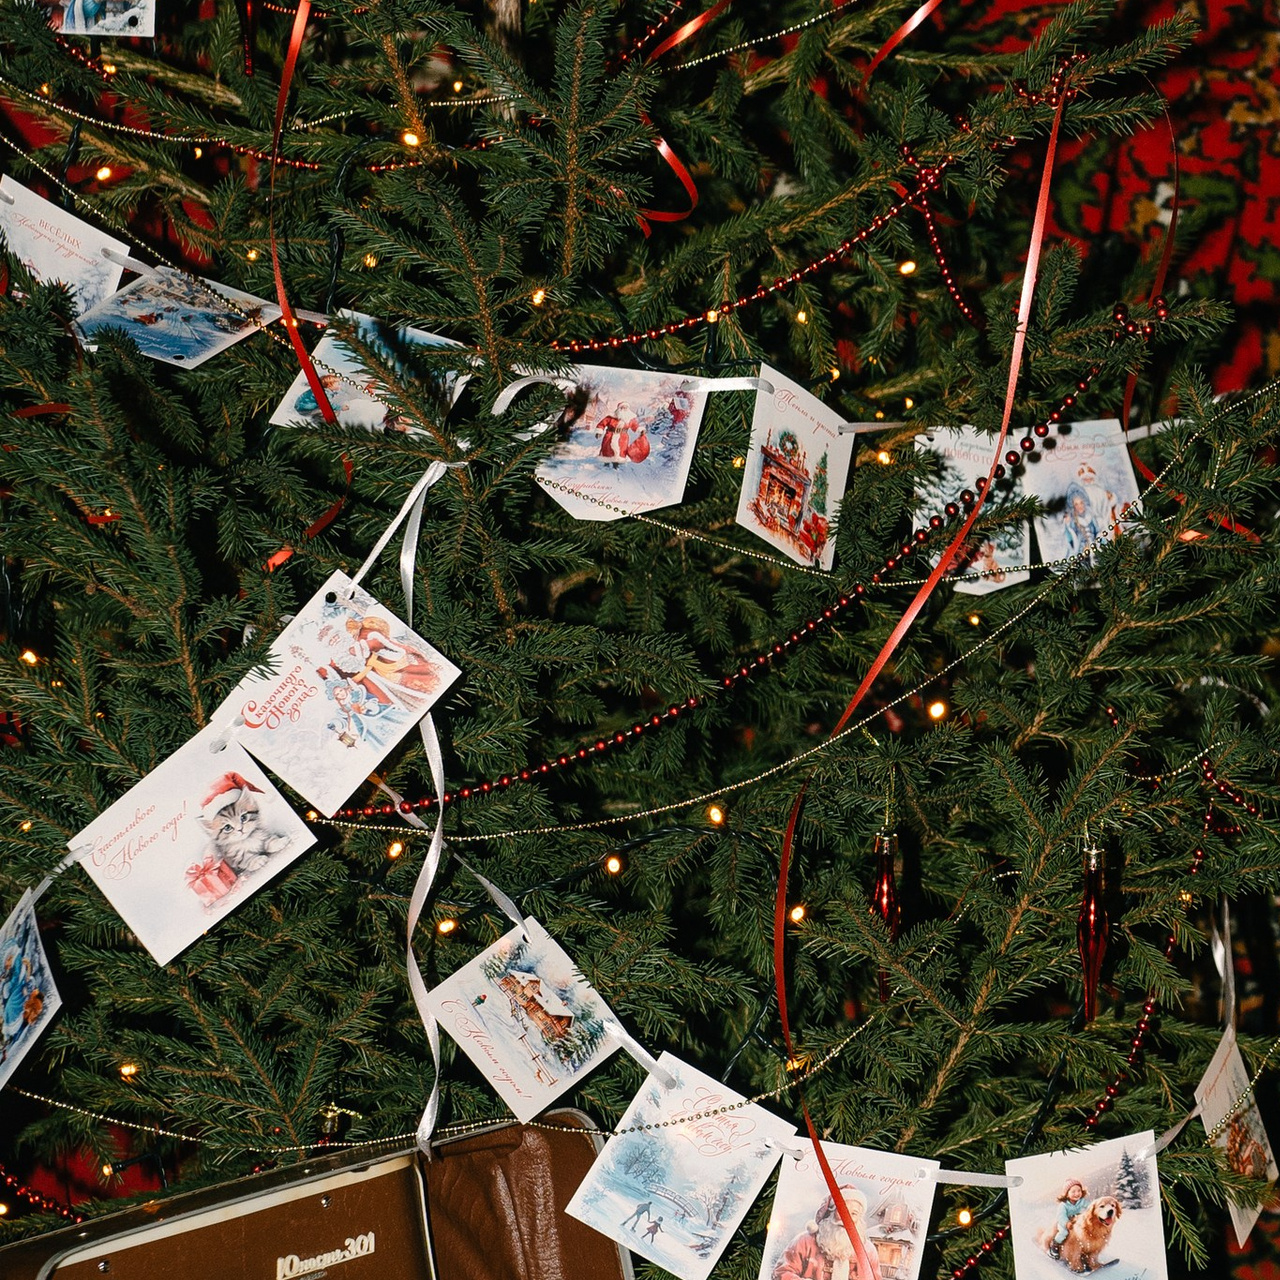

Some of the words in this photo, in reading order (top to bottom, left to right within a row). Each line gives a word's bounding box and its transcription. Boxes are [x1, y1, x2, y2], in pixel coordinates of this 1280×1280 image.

[40, 219, 81, 249] ВЕСЁЛЫХ
[241, 665, 301, 728] Сказочного
[266, 679, 308, 729] Нового
[286, 686, 318, 722] года
[103, 835, 158, 880] Нового
[161, 800, 187, 842] года!
